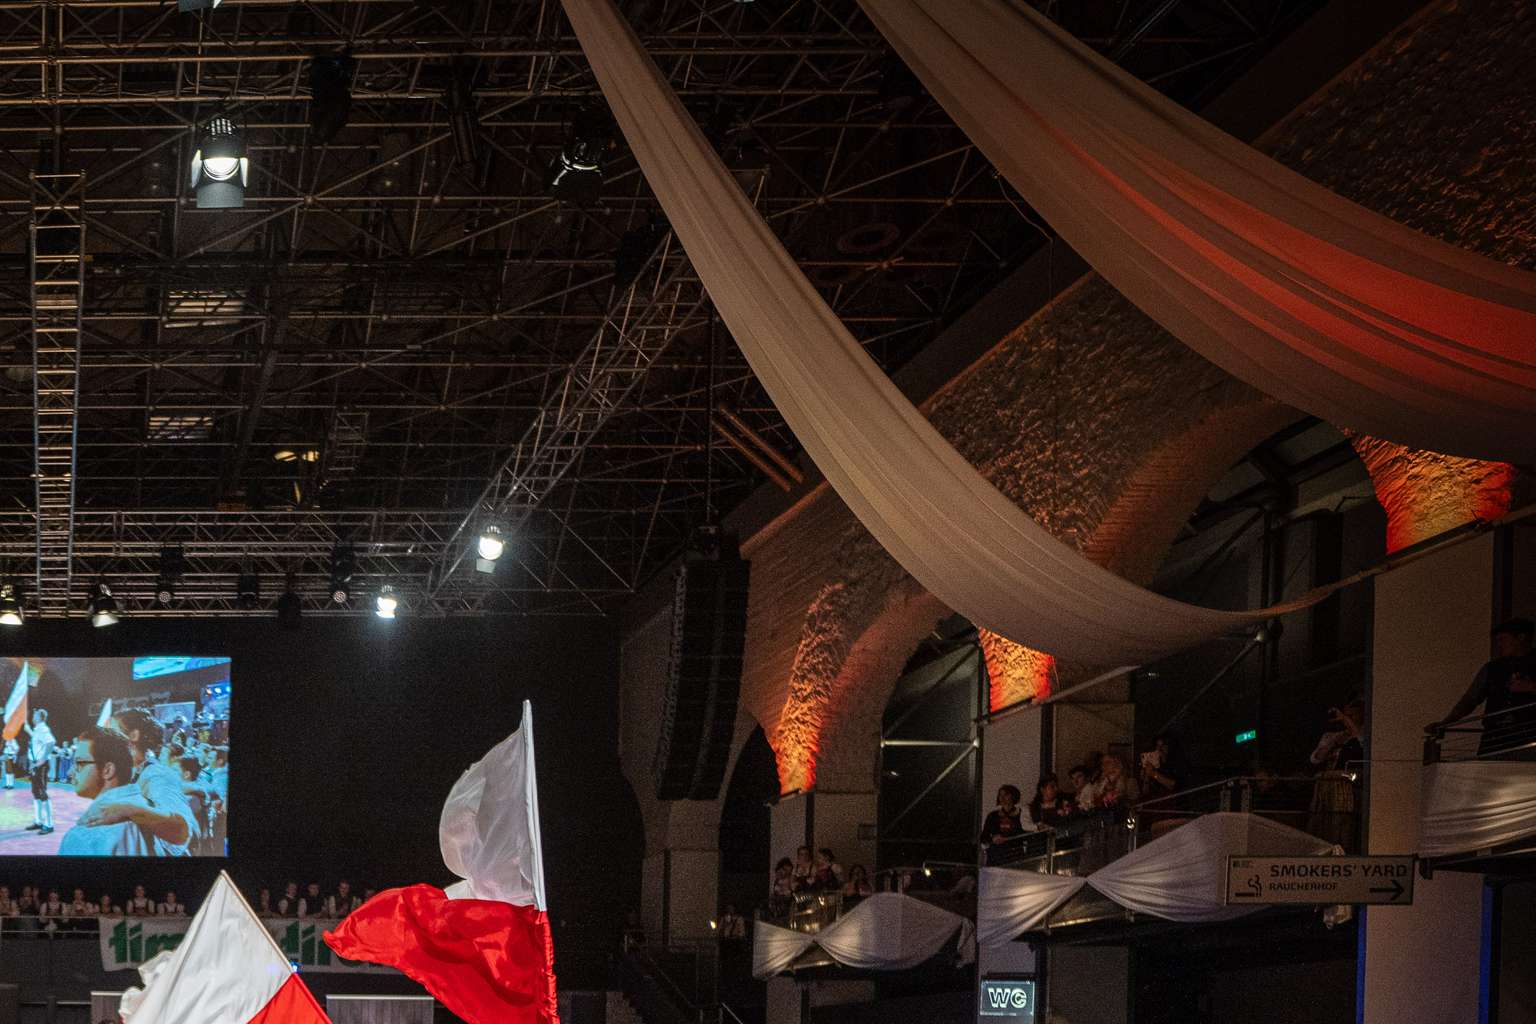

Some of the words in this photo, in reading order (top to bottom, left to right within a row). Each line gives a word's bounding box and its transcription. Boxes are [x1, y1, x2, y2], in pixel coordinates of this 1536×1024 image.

[1270, 864, 1356, 877] SMOKERS'
[1362, 864, 1408, 877] YARD
[988, 988, 1027, 1008] WC
